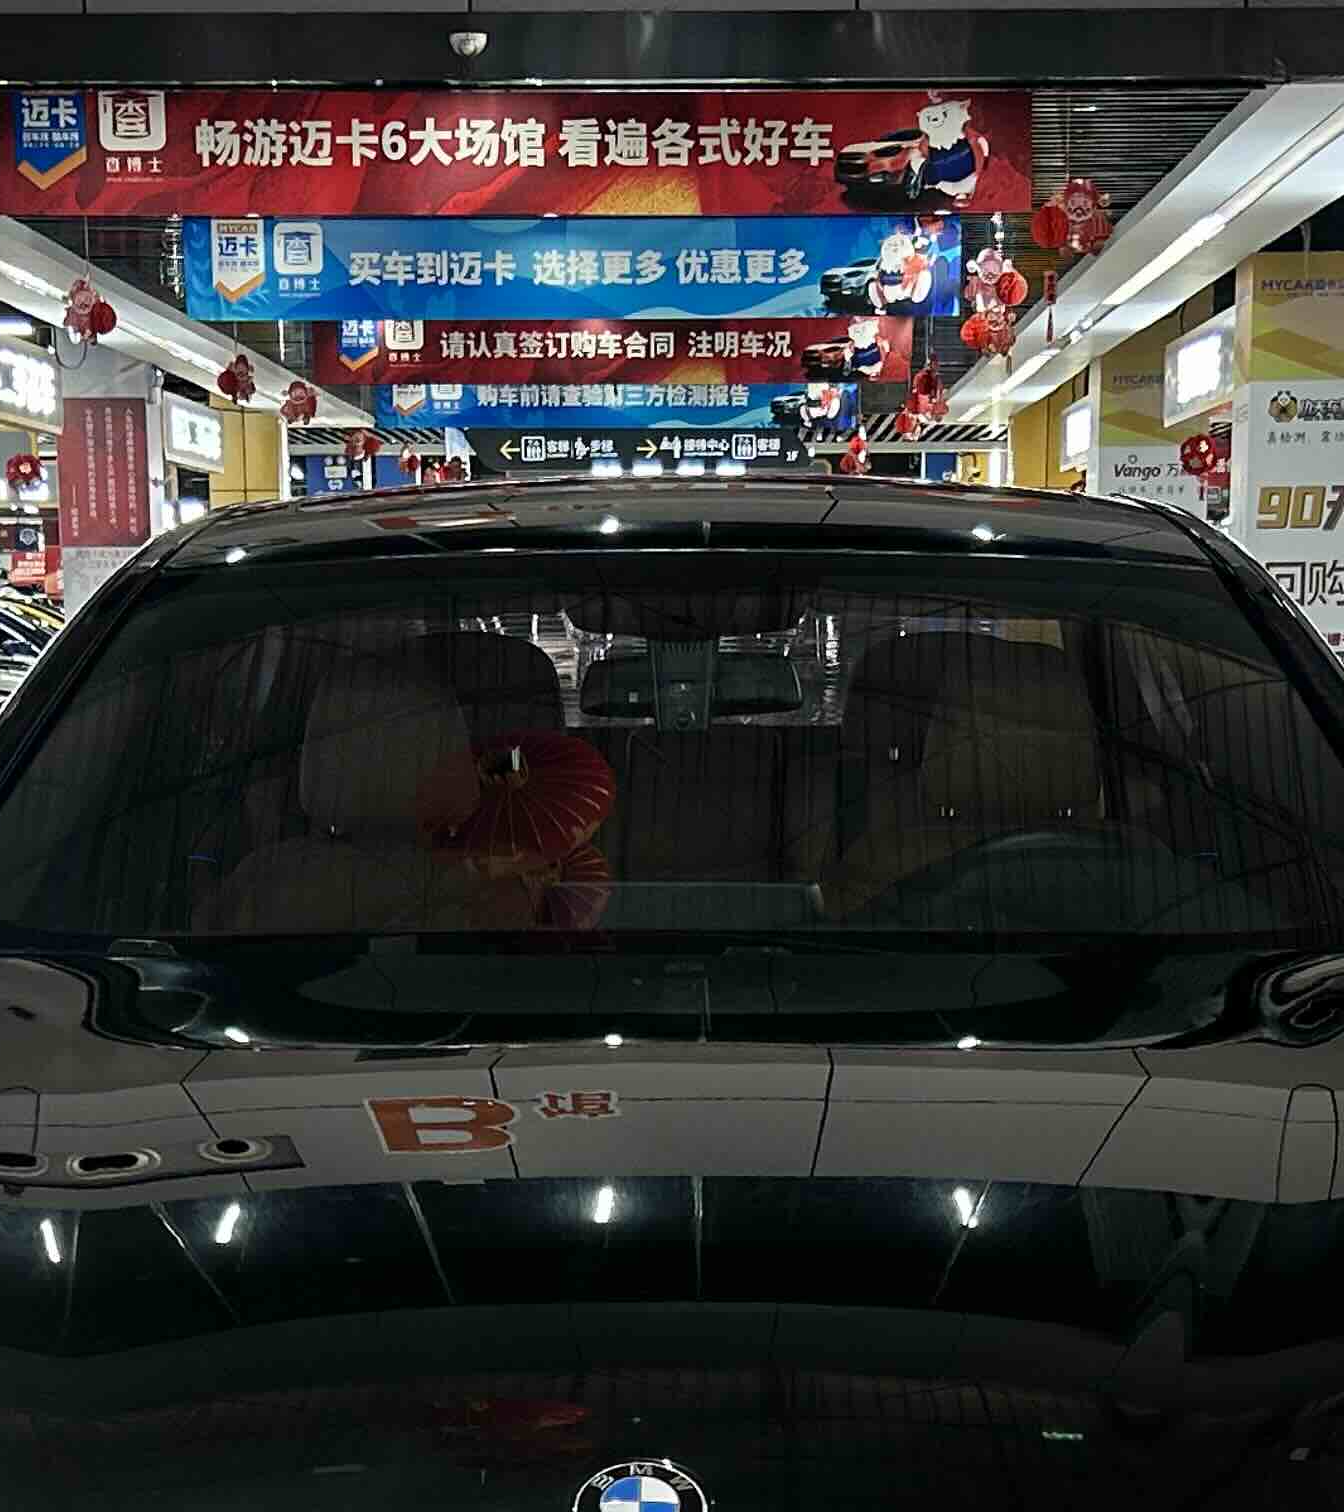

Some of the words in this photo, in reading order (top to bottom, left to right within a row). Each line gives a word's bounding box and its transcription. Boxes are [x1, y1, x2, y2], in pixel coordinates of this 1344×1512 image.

[21, 98, 77, 128] 迈卡
[195, 118, 546, 168] 畅游迈卡6大场馆
[559, 118, 834, 168] 看遍各式好车
[218, 235, 258, 257] 迈卡
[349, 250, 516, 287] 买车到迈卡
[534, 248, 666, 286] 选择更多
[676, 247, 810, 286] 优惠更多
[440, 331, 674, 360] 请认真签订购车合同
[687, 330, 793, 359] 注明车况
[1114, 463, 1161, 481] Vango
[591, 1463, 694, 1492] BMW
